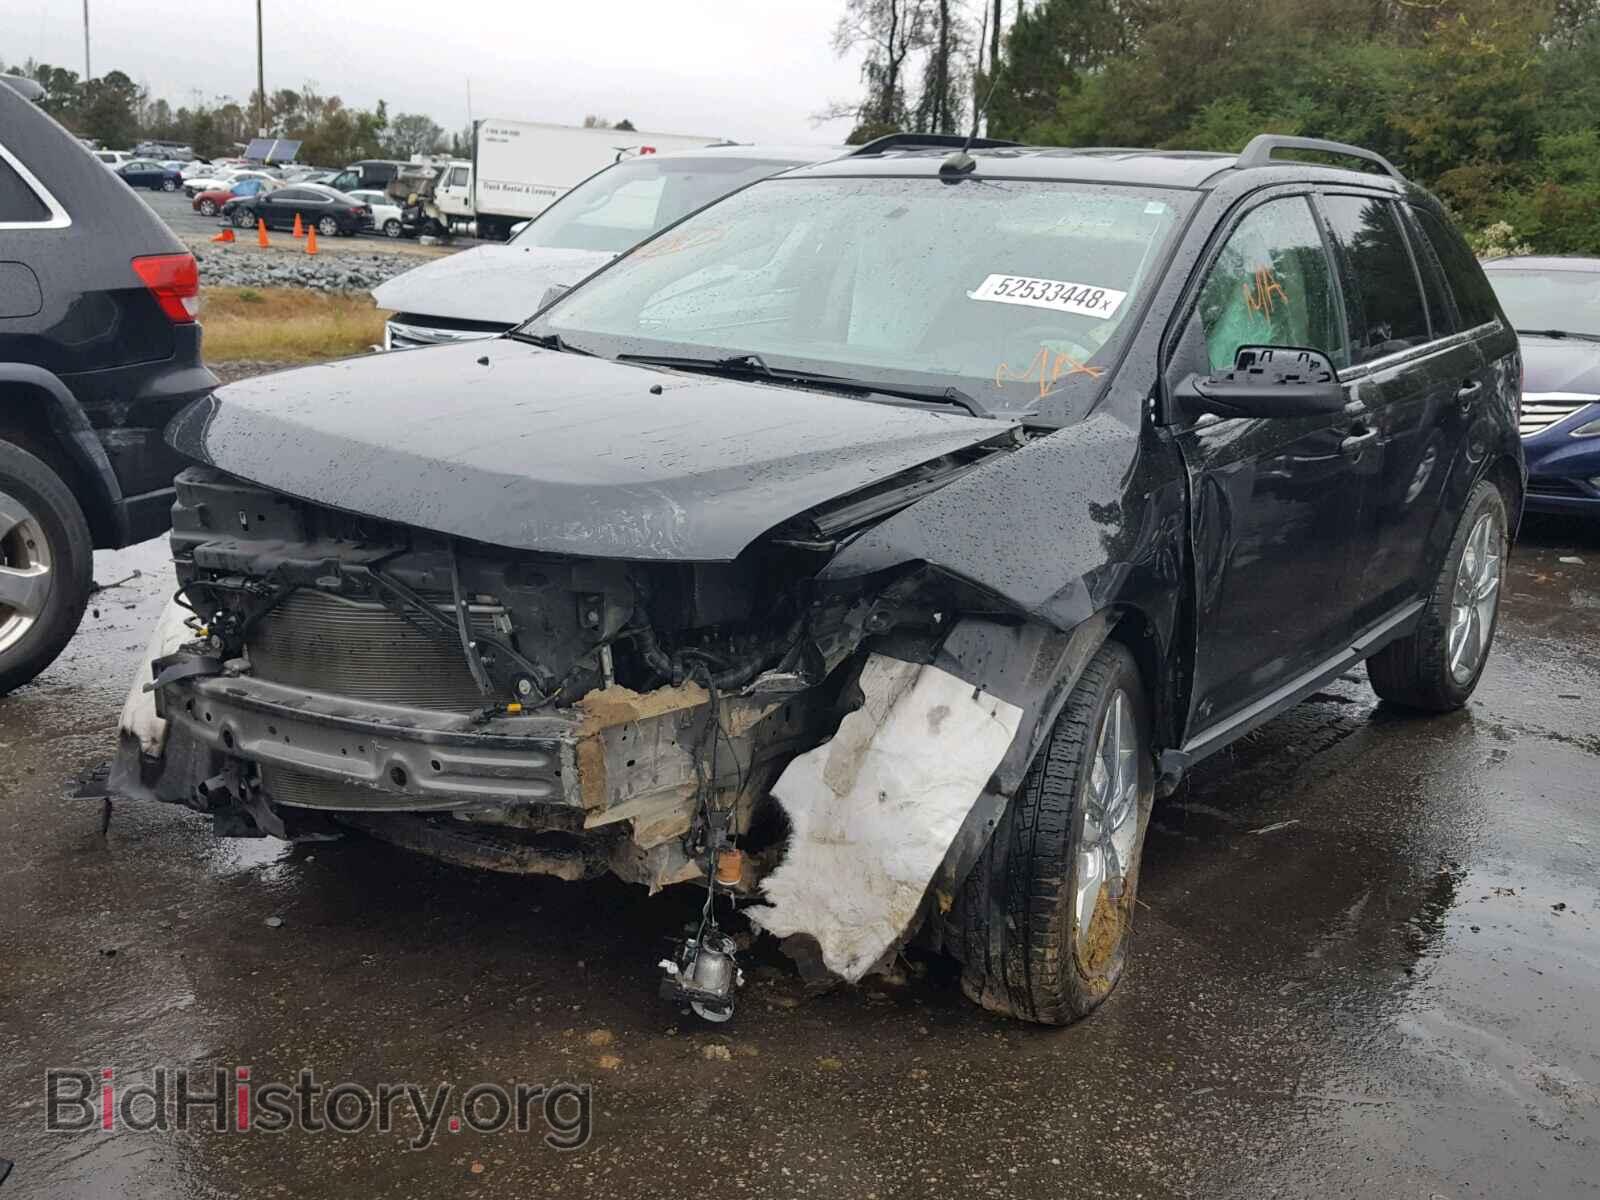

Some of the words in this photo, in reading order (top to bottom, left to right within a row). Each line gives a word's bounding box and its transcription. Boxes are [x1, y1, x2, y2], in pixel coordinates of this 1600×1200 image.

[483, 182, 501, 192] Truck
[503, 184, 523, 193] Rental
[531, 185, 557, 197] Leasing
